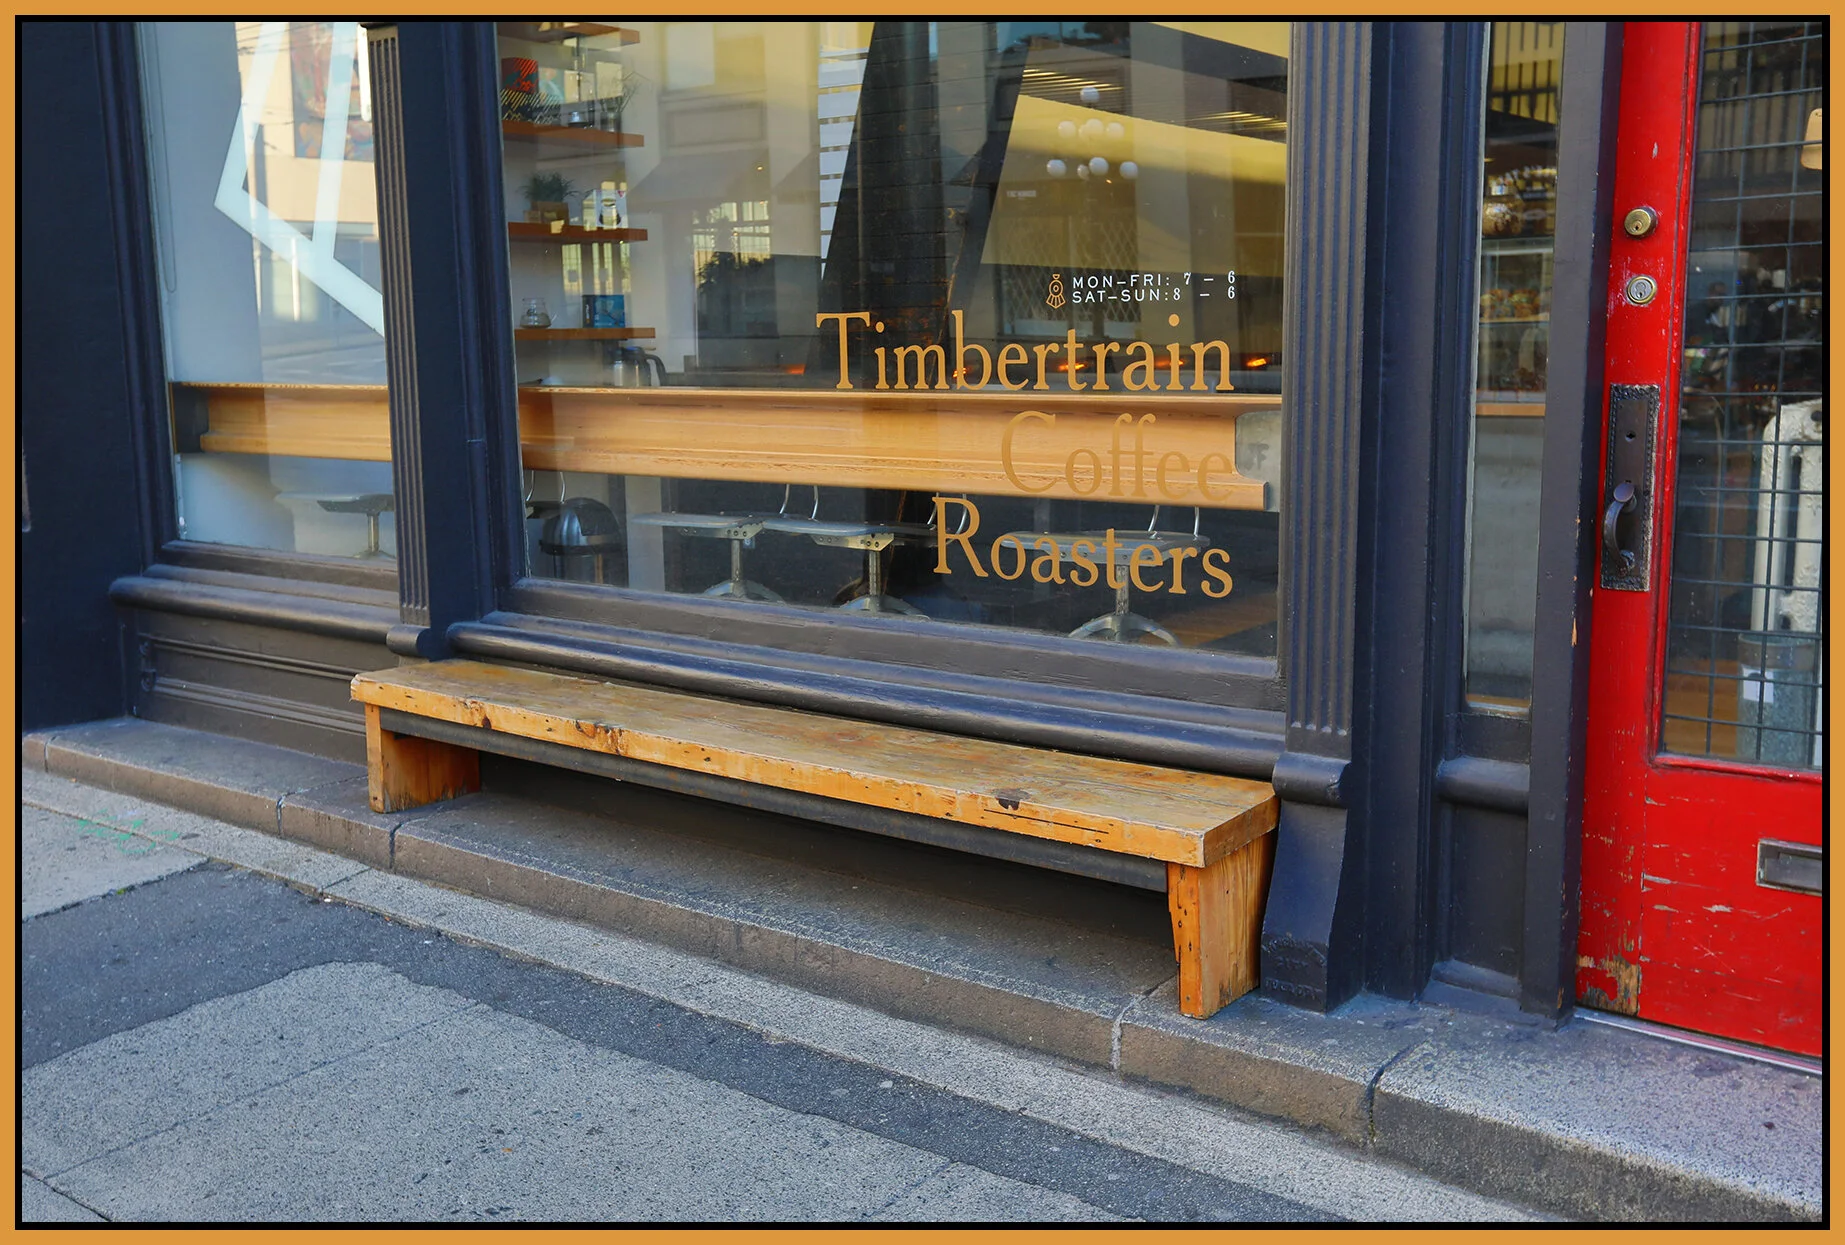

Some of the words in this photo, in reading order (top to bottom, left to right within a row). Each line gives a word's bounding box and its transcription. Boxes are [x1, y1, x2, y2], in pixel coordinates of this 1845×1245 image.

[1183, 272, 1192, 285] 7
[1227, 270, 1236, 284] 6
[1227, 285, 1236, 299] 6
[816, 310, 1234, 391] Timbertrain
[1001, 410, 1233, 501] Coffee
[932, 497, 1234, 599] Roasters
